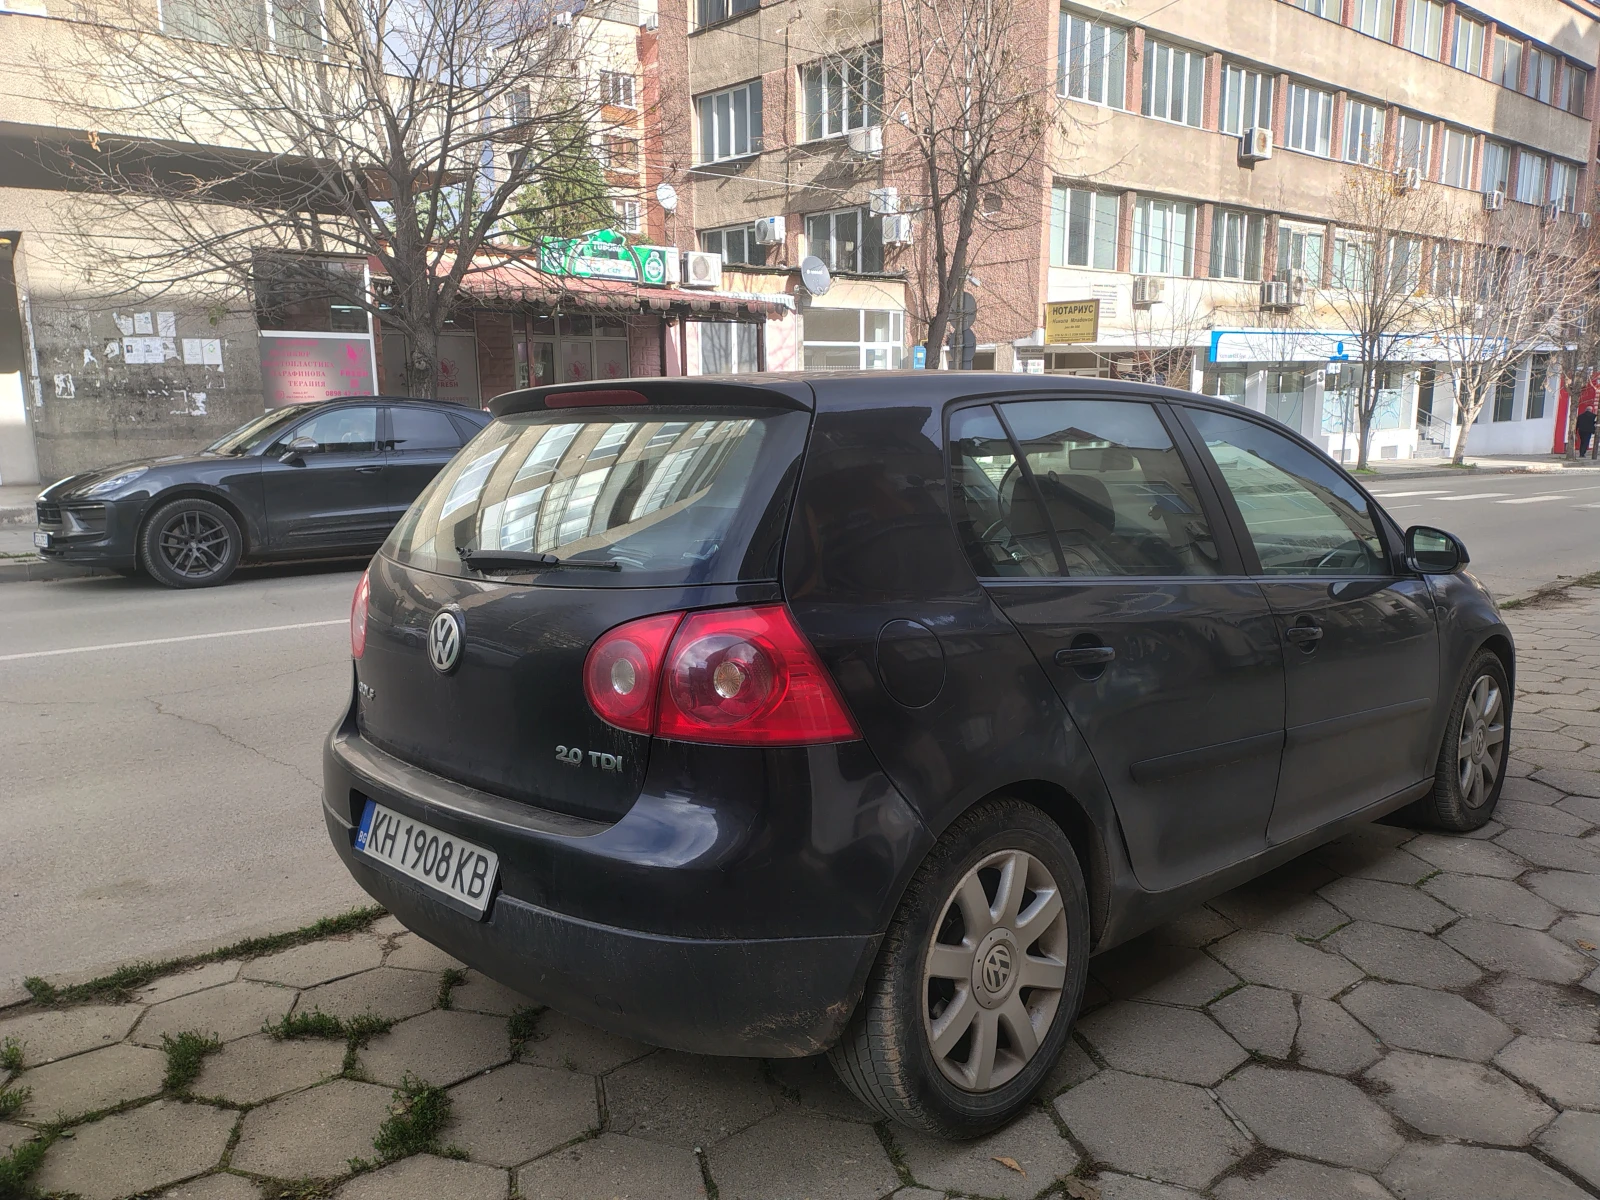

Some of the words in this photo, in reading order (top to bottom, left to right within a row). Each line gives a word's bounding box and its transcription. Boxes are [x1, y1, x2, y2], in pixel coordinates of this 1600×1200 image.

[1052, 305, 1094, 315] НОТАРИУС
[287, 380, 327, 388] ТЕРАПИЯ
[588, 750, 623, 772] TDI
[358, 830, 368, 843] BG
[368, 810, 489, 899] KH1908KB
